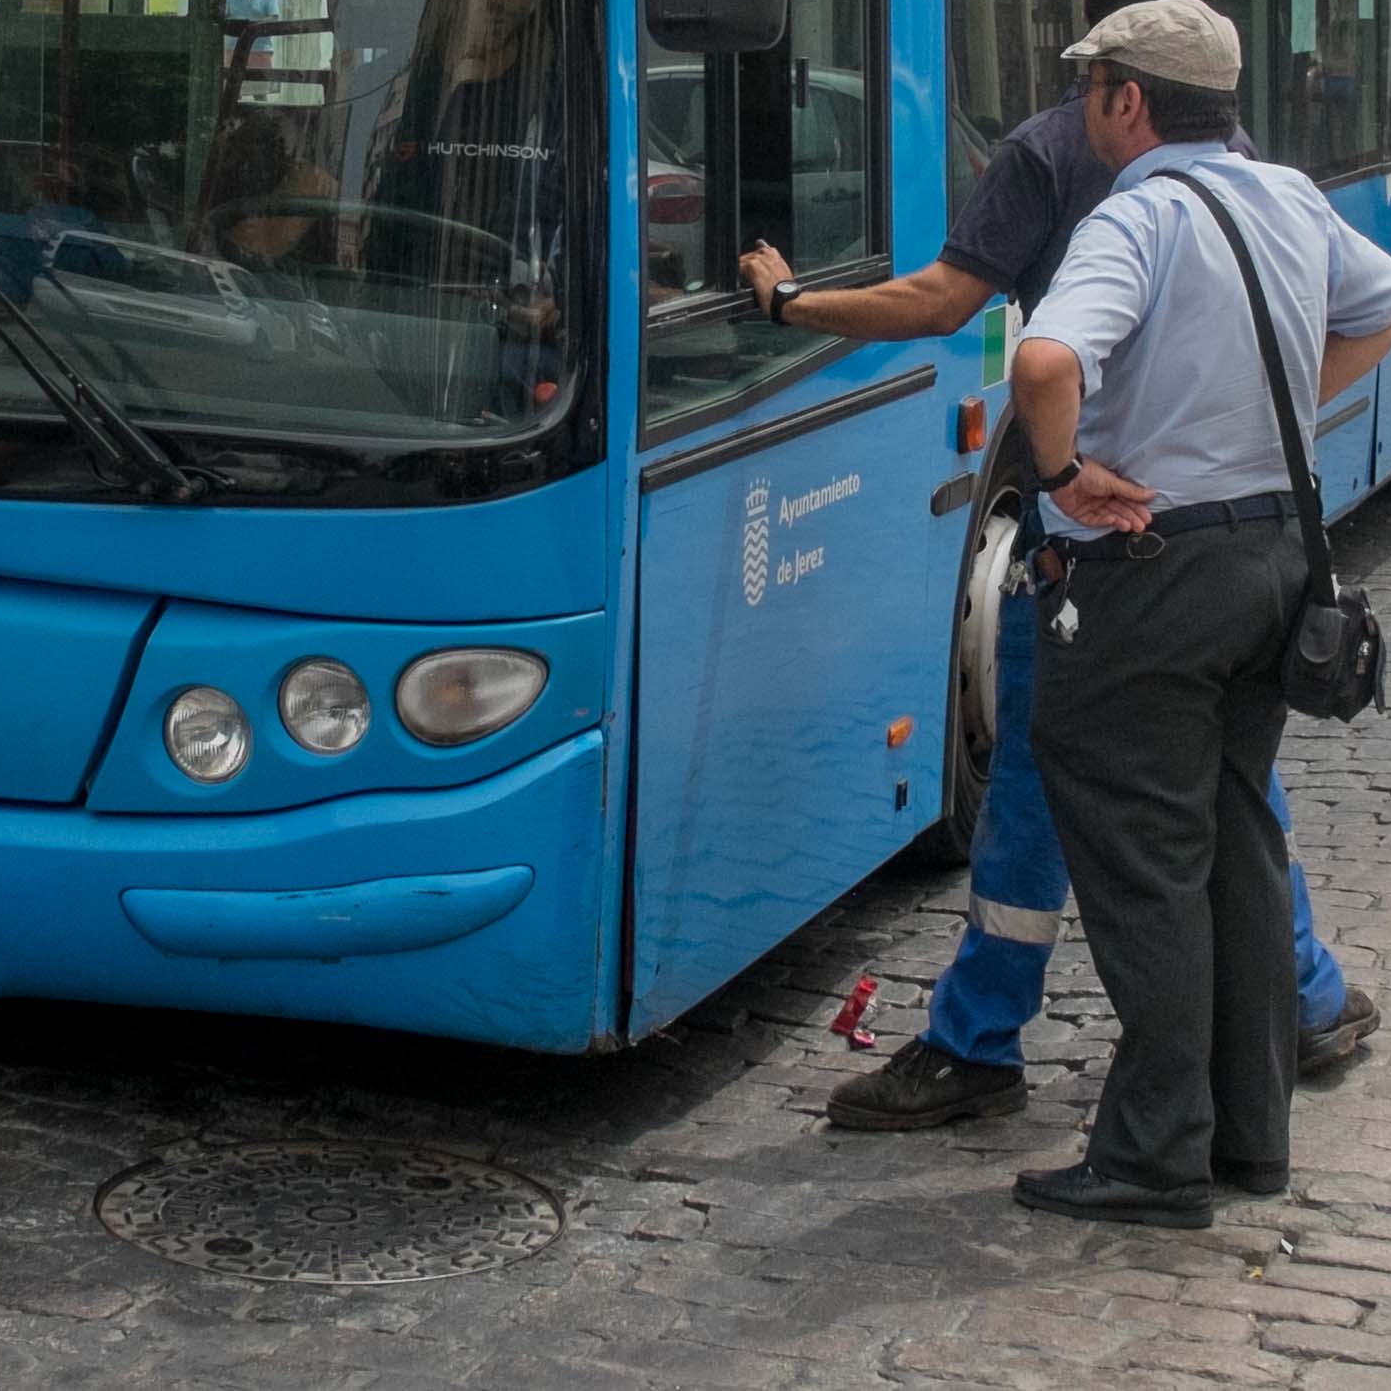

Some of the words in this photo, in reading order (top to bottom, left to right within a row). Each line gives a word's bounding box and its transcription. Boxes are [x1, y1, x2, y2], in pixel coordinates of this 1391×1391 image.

[428, 142, 548, 160] HUTCHINSON
[778, 473, 861, 529] Ayuntamiento
[777, 556, 792, 585] de
[794, 547, 825, 586] Jerez
